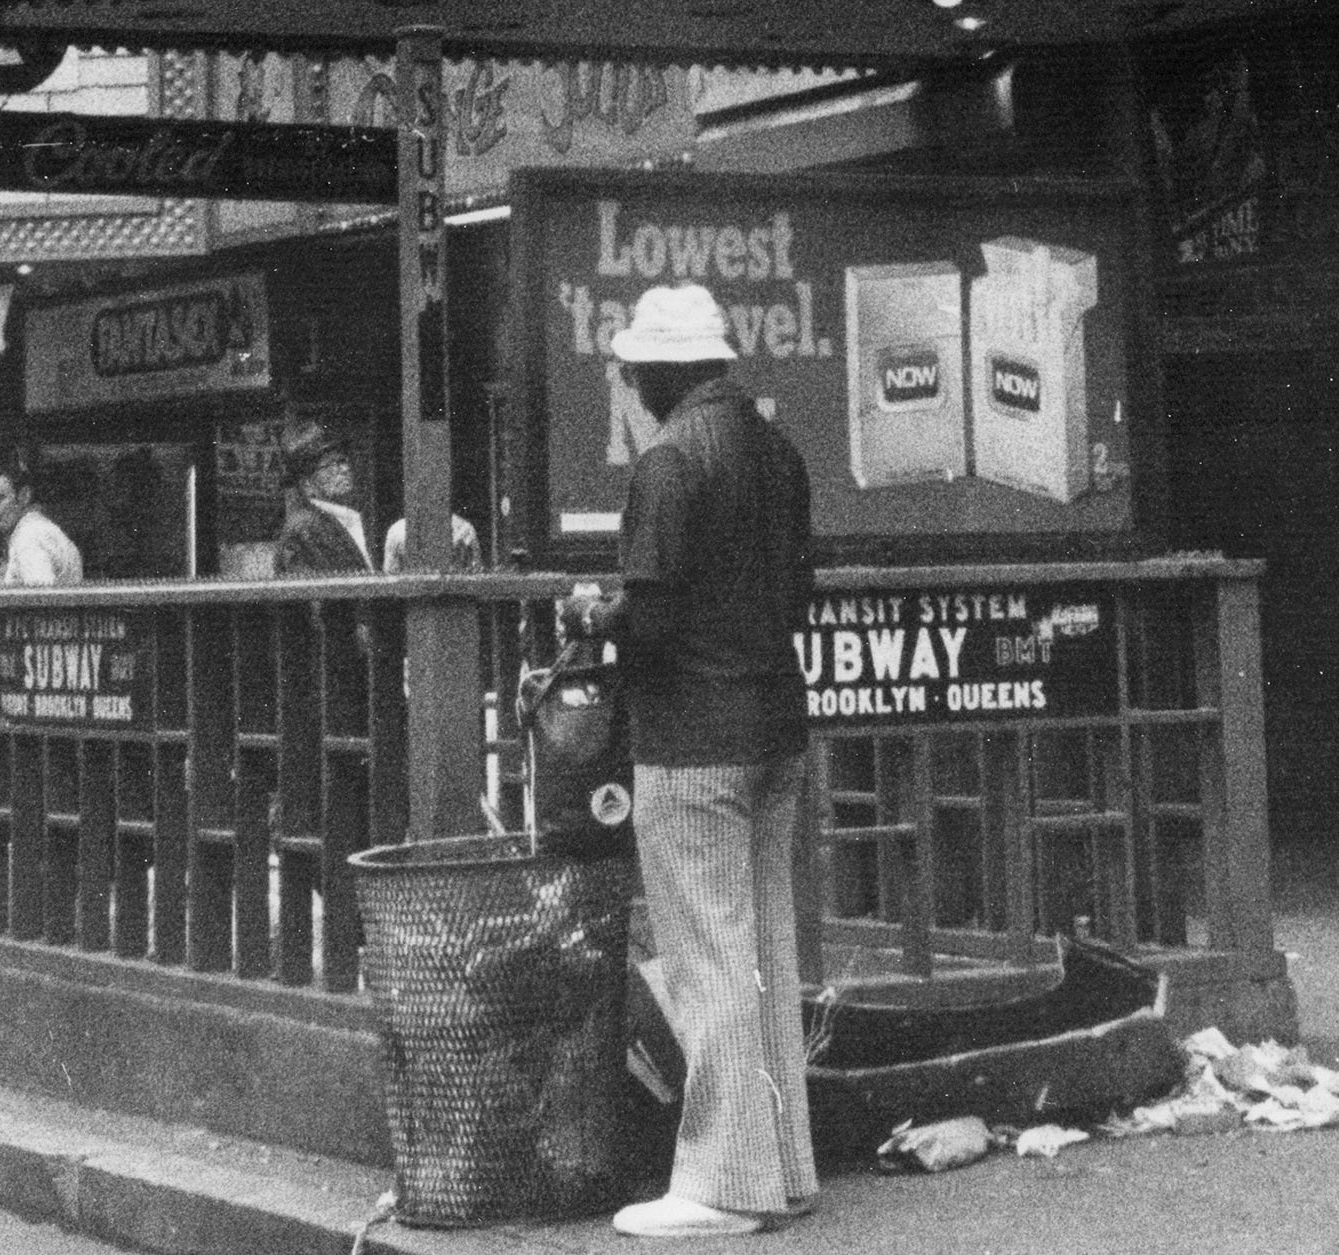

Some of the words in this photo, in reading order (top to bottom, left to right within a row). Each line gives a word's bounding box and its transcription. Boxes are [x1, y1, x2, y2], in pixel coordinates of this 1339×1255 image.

[596, 200, 794, 279] Lowest
[885, 365, 936, 390] NOW
[995, 371, 1038, 400] NOW
[808, 598, 903, 626] ANSIT
[918, 594, 1028, 623] SYSTEM
[23, 644, 103, 690] SUBWAY
[793, 626, 968, 686] UBWAY
[807, 685, 927, 717] ROOKLYN
[947, 680, 1048, 711] QUEENS
